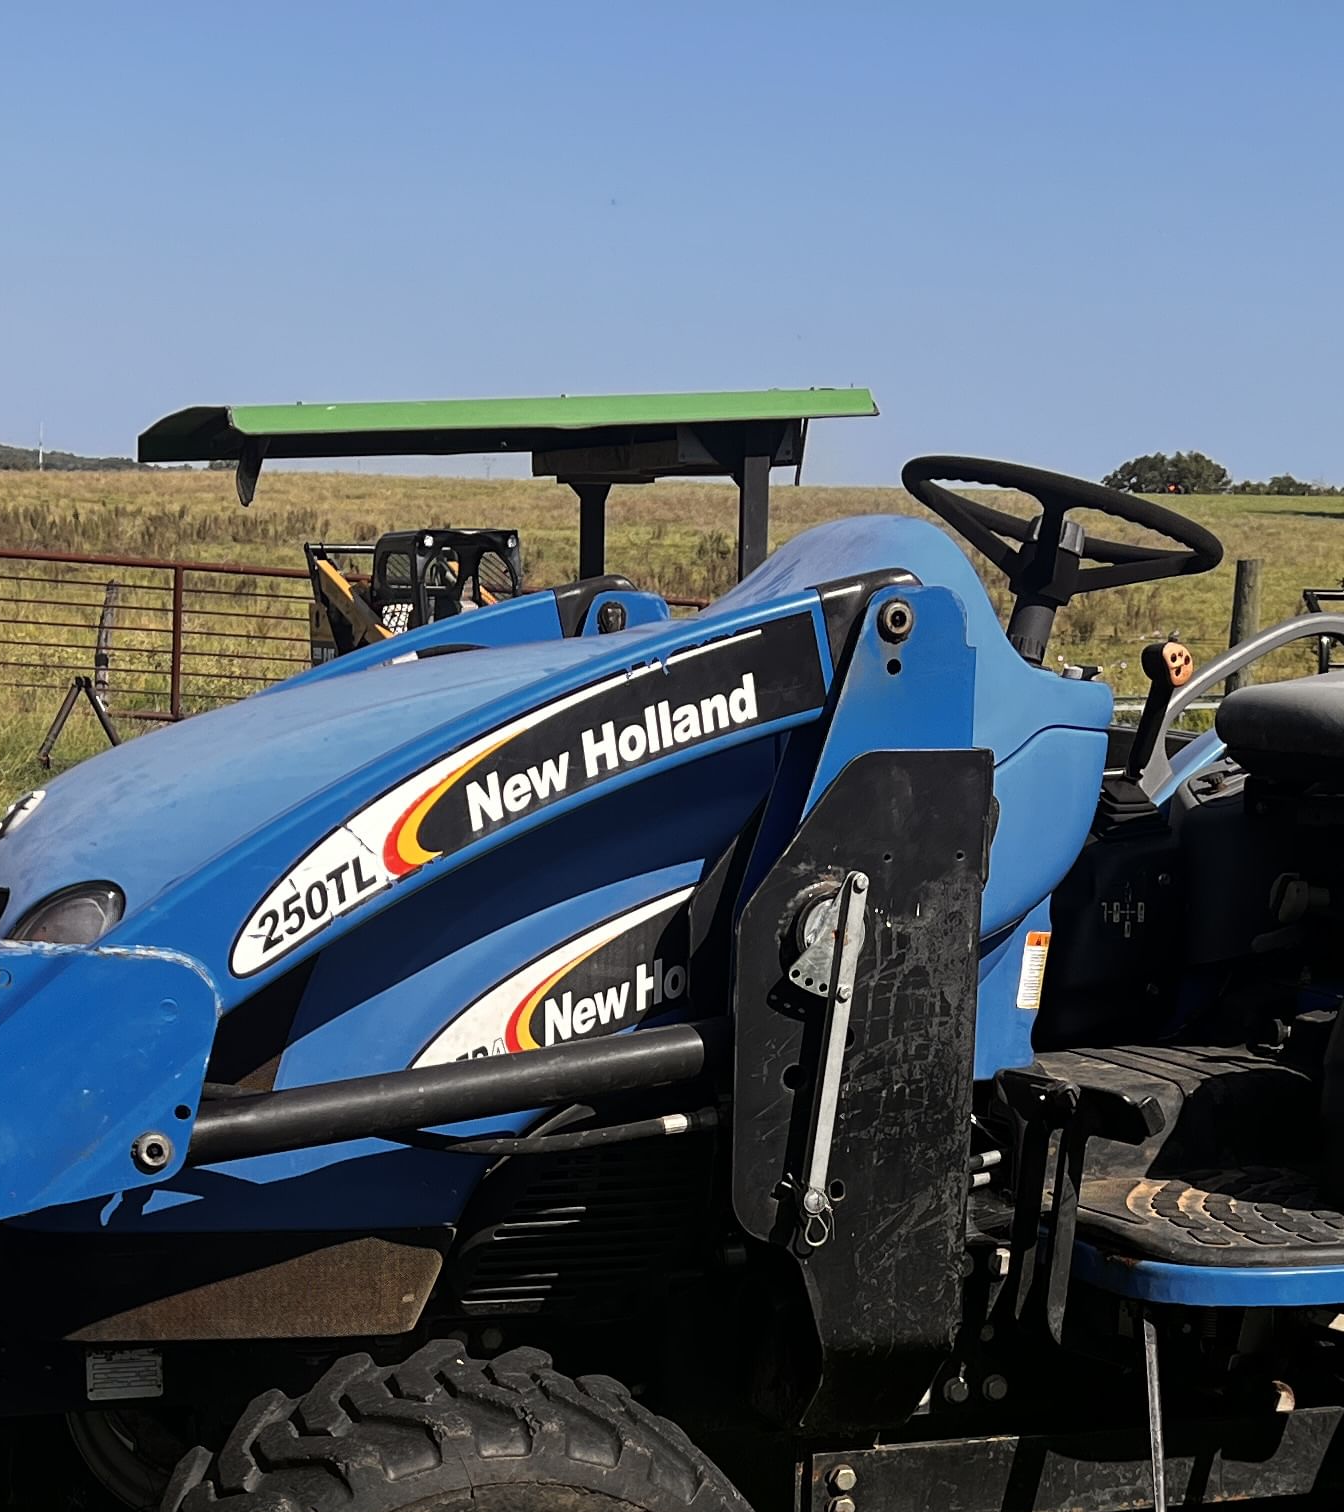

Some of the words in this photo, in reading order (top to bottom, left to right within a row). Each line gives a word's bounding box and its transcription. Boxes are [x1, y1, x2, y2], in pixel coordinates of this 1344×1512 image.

[464, 749, 570, 832] New
[581, 673, 759, 779] Holland
[258, 855, 378, 953] 250TL
[542, 977, 630, 1046] New
[635, 957, 688, 1013] Ho
